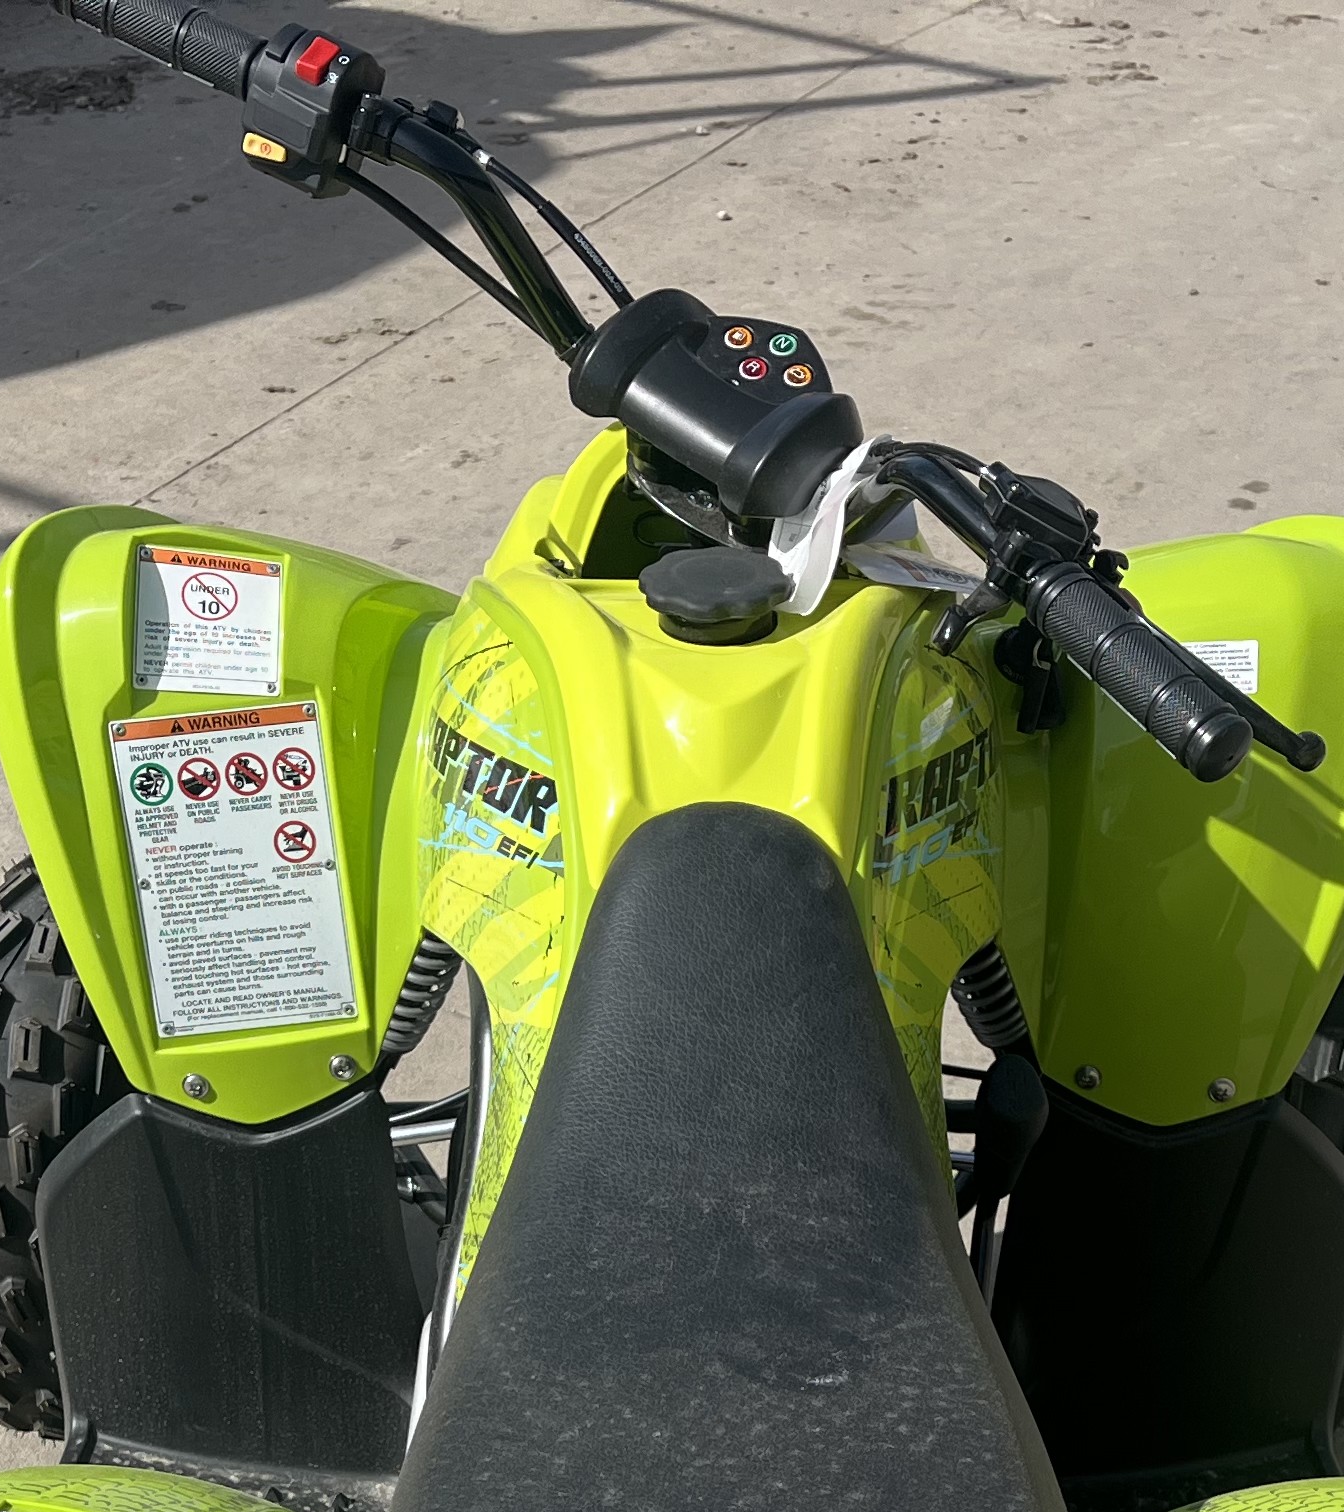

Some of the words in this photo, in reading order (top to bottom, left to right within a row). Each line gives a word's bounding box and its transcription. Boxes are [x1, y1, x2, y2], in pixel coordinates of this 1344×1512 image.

[776, 336, 791, 349] N
[746, 360, 760, 373] R
[187, 556, 252, 572] WARNING
[190, 584, 229, 595] UNDER
[199, 600, 220, 614] 10
[188, 712, 260, 731] WARNING
[128, 743, 169, 753] Improper
[172, 739, 190, 748] ATV
[229, 732, 255, 741] result
[268, 726, 304, 737] SEVERE
[130, 751, 164, 761] INJURY
[179, 746, 213, 756] DEATH.
[250, 795, 271, 803] CARRY
[134, 806, 161, 815] ALWAYS
[197, 807, 220, 816] PUBLIC
[137, 821, 161, 830] HELMET
[444, 802, 503, 849] 110
[497, 835, 540, 869] EFI
[145, 845, 176, 855] NEVER
[179, 842, 213, 852] operate
[151, 853, 182, 862] without
[183, 851, 210, 860] proper
[212, 847, 243, 856] training
[889, 823, 955, 886] 110
[164, 860, 208, 869] instruction.
[164, 869, 193, 878] speeds
[240, 862, 258, 870] your
[203, 872, 247, 881] conditions.
[290, 869, 322, 878] SURFACES
[169, 885, 193, 894] public
[195, 882, 218, 890] roads
[232, 878, 265, 886] collision
[175, 893, 198, 901] occur
[219, 887, 250, 896] another
[251, 884, 281, 892] vehicle.
[185, 898, 226, 909] passenger
[234, 893, 280, 903] passengers
[282, 889, 305, 897] affect
[161, 910, 192, 918] balance
[211, 904, 244, 913] steering
[245, 901, 260, 909] and
[262, 899, 296, 907] increase
[198, 913, 228, 922] control.
[159, 926, 197, 936] ALWAYS
[181, 934, 207, 943] proper
[234, 927, 277, 936] techniques
[289, 922, 310, 930] avoid
[166, 943, 194, 951] vehicle
[196, 939, 234, 948] overturns
[282, 931, 306, 939] rough
[169, 958, 190, 967] avoid
[192, 956, 216, 965] paved
[218, 953, 252, 961] surfaces
[259, 947, 298, 958] pavement
[170, 965, 205, 974] seriously
[207, 962, 230, 970] affect
[232, 959, 266, 967] handling
[268, 956, 282, 964] and
[284, 953, 314, 962] control.
[171, 974, 192, 982] avoid
[194, 971, 229, 980] touching
[246, 966, 279, 974] surfaces
[172, 981, 204, 990] exhaust
[205, 978, 234, 987] system
[276, 968, 323, 978] surrounding
[174, 990, 194, 998] parts
[181, 998, 212, 1007] LOCATE
[255, 990, 291, 999] OWNER'S
[172, 1007, 205, 1016] FOLLOW
[223, 999, 280, 1010] INSTRUCTIONS
